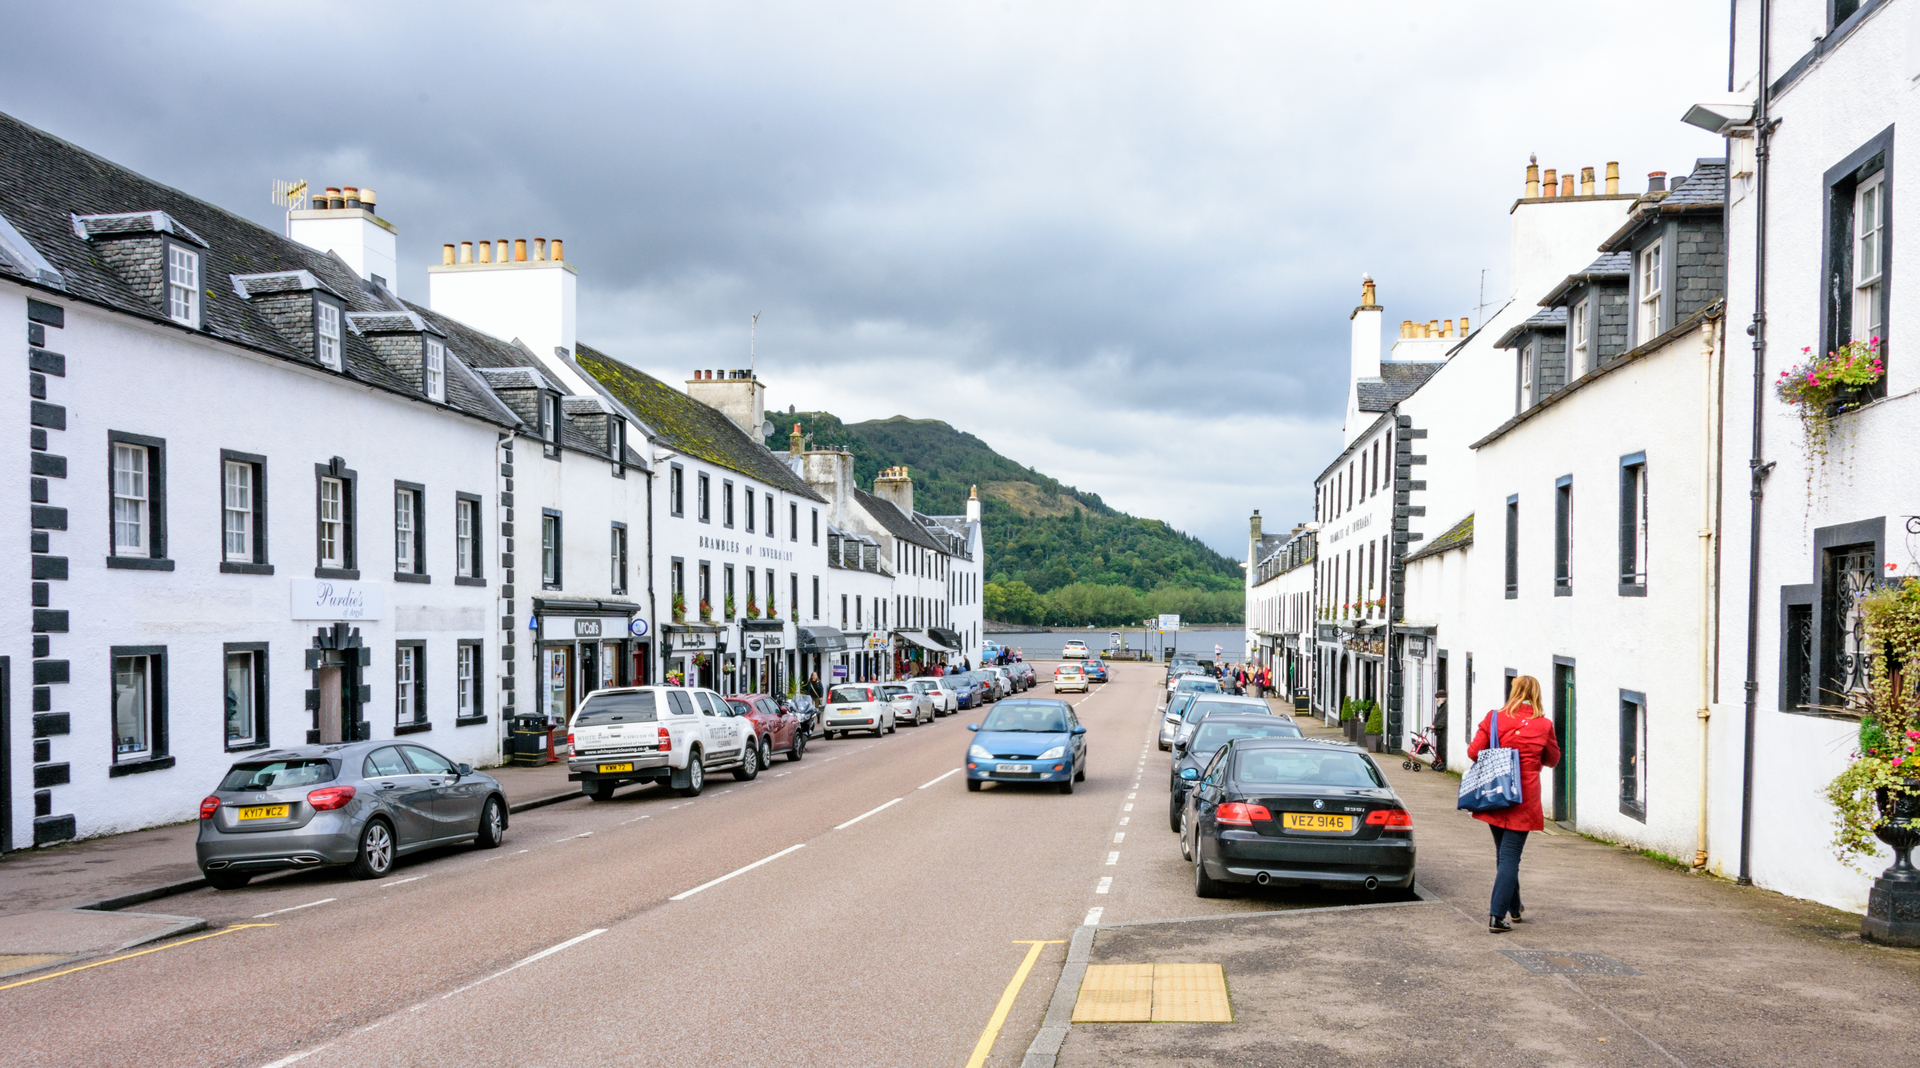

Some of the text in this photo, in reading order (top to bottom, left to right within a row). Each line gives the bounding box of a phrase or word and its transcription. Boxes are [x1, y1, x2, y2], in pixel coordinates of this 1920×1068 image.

[699, 535, 740, 553] BRAMBLES
[746, 545, 753, 555] of
[316, 582, 363, 607] Purdie's
[578, 621, 599, 635] McColl's
[709, 727, 728, 740] WHITE
[584, 746, 650, 755] www.whitepearlcleaning.co.uk
[244, 806, 283, 818] KY17 WCZ
[1291, 815, 1344, 828] VEZ 9146
